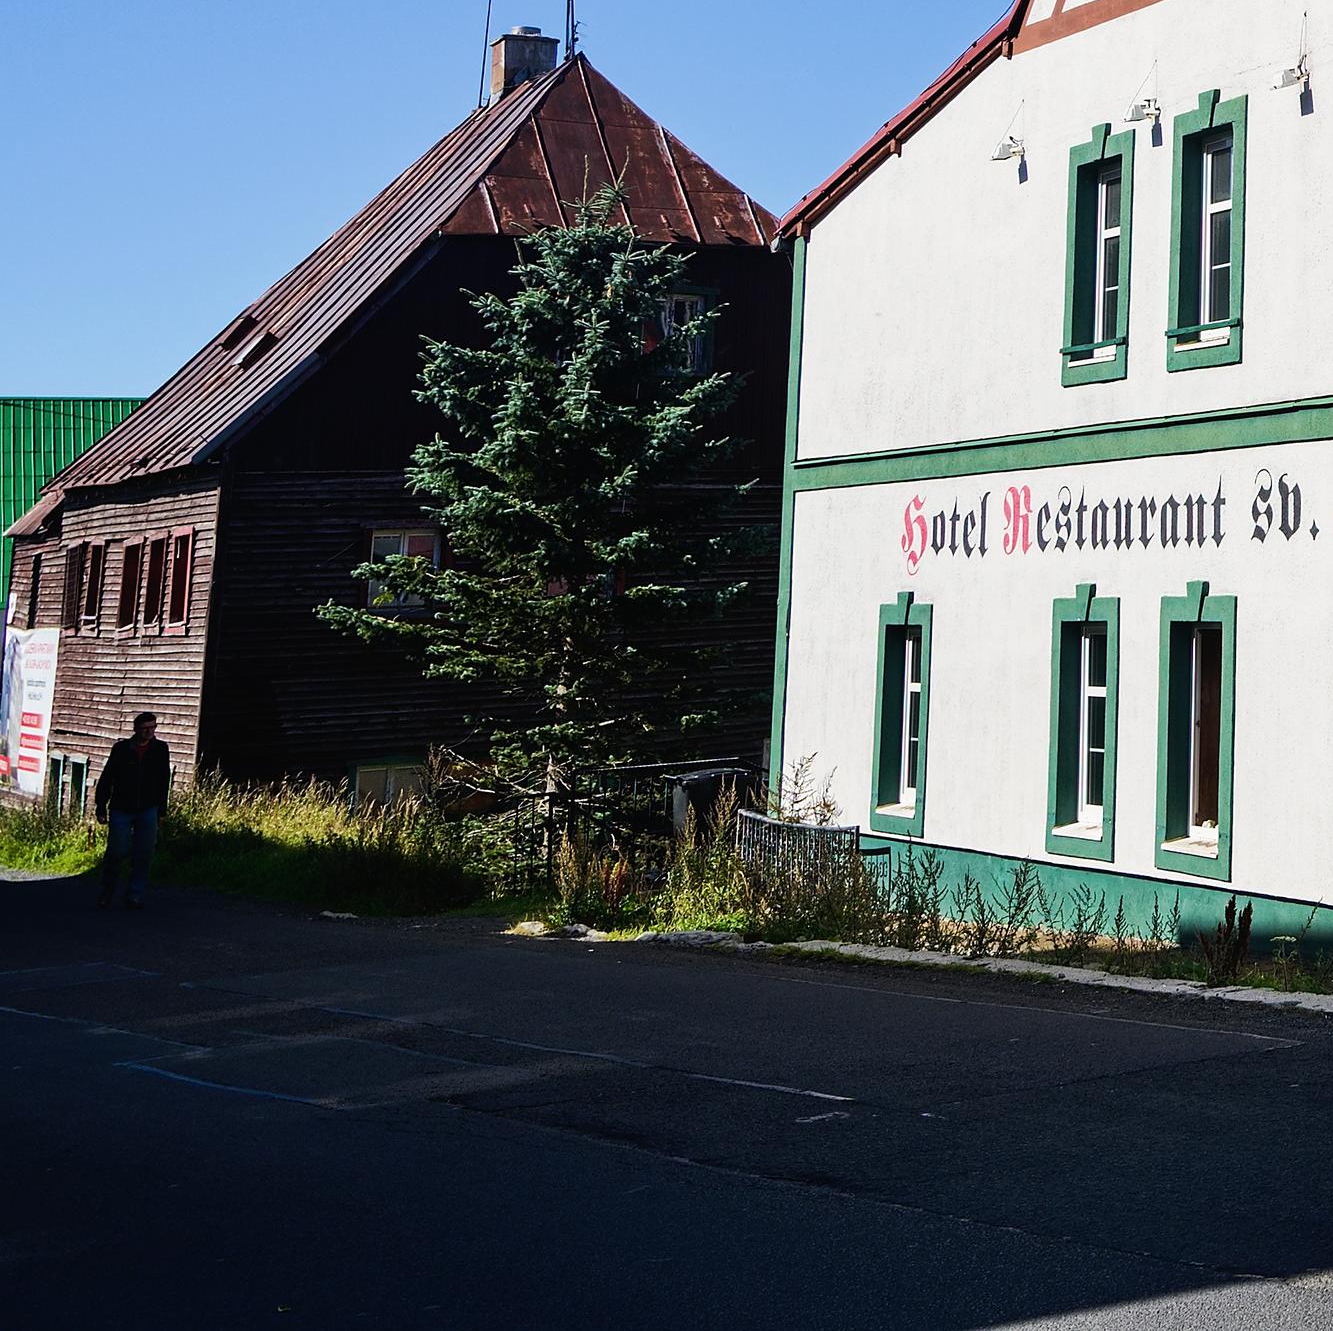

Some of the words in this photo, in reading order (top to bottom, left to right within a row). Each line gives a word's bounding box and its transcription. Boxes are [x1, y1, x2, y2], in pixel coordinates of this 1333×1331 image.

[901, 491, 991, 576] Hotel
[1003, 475, 1226, 557] Restaurant
[1250, 468, 1320, 544] sv.
